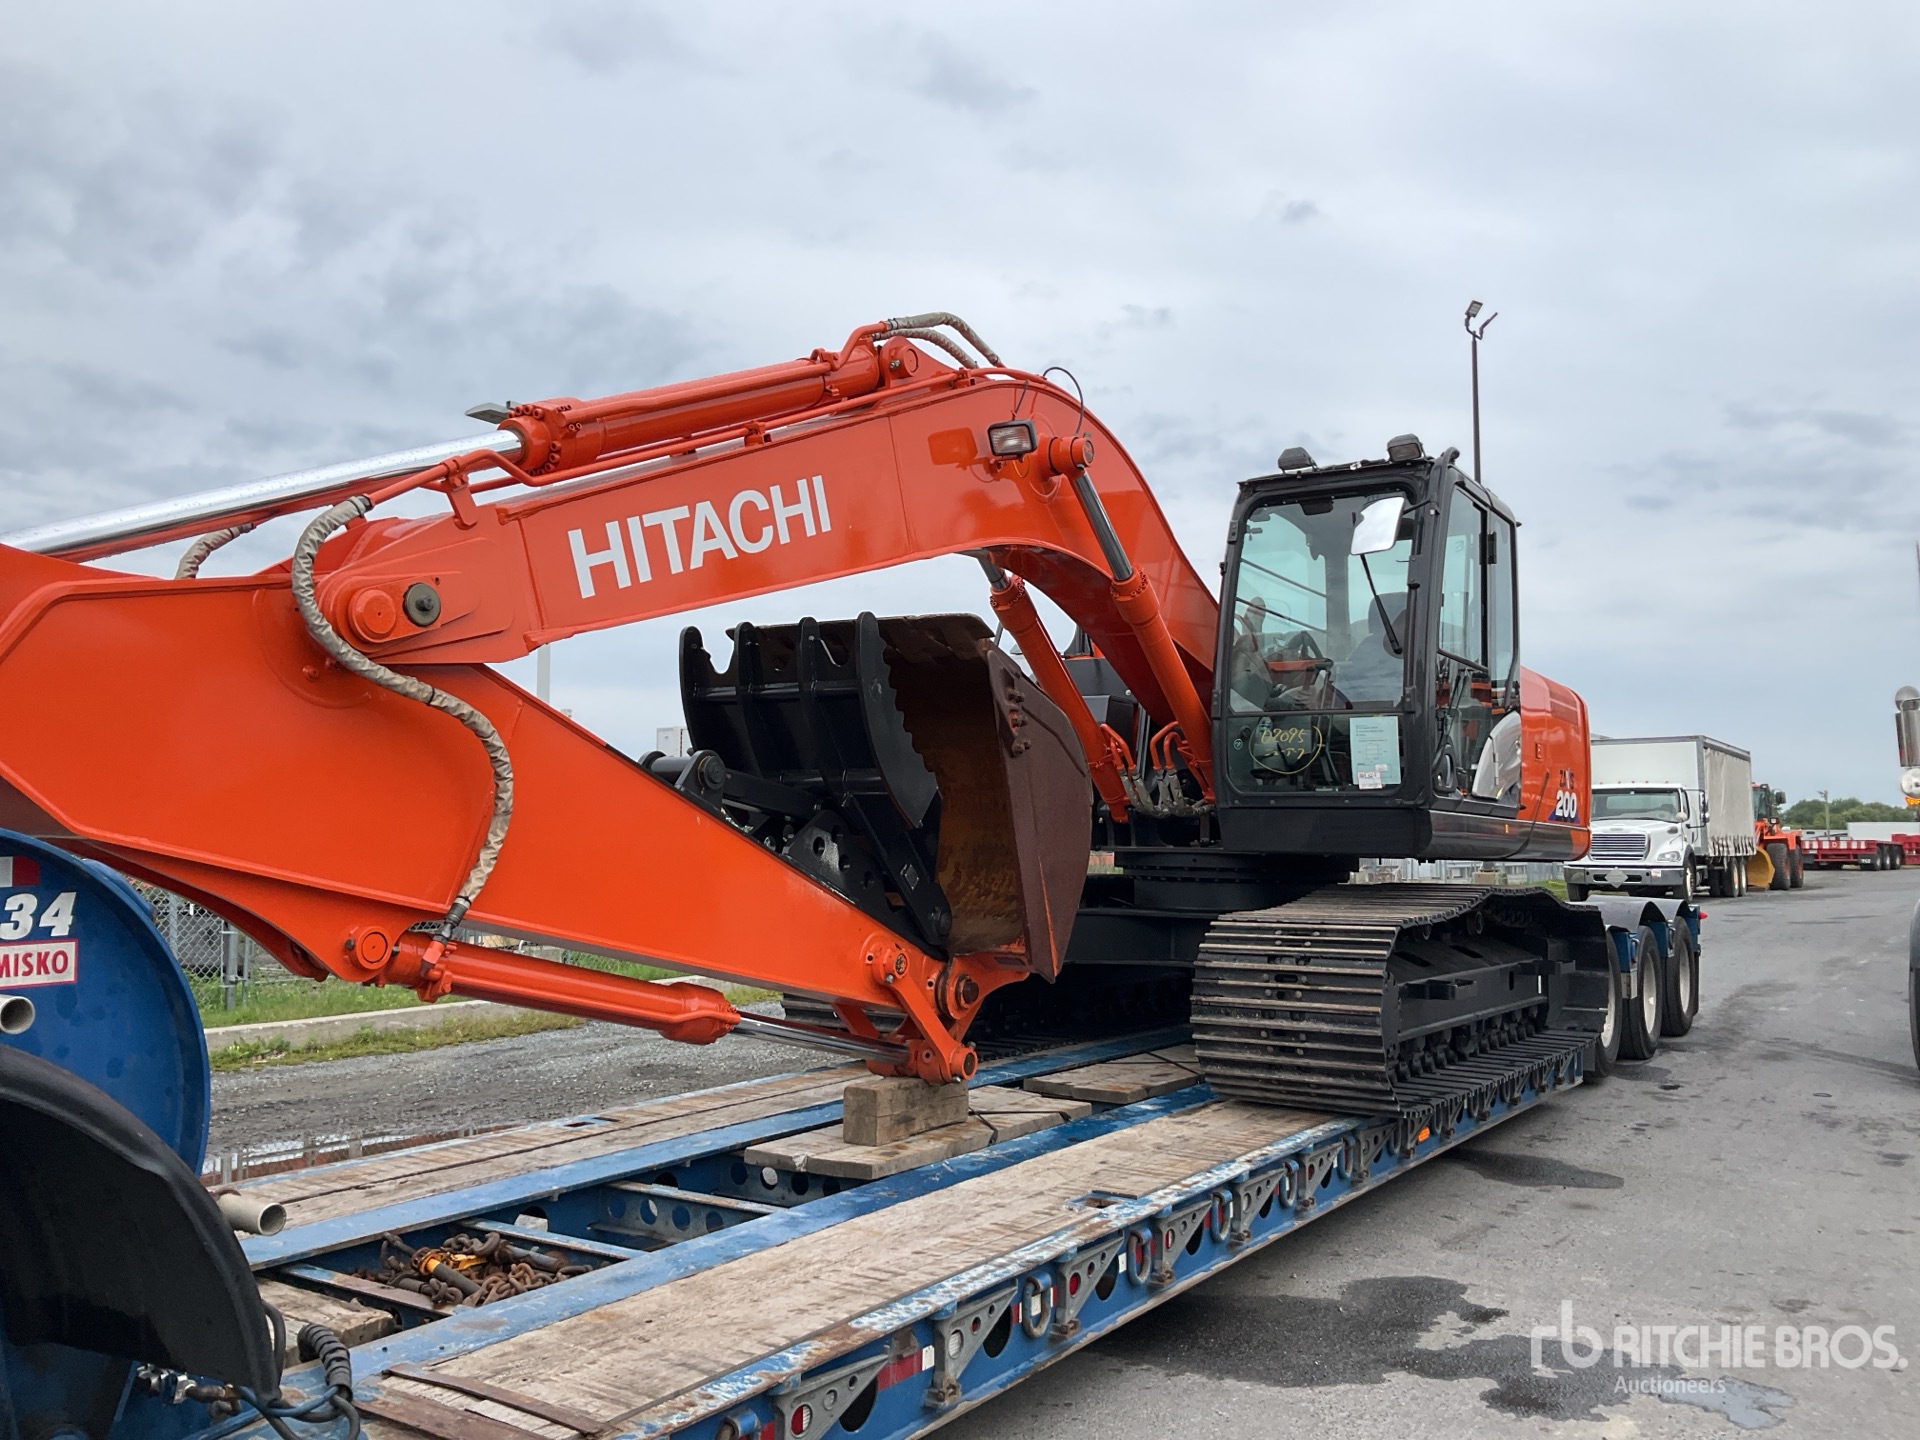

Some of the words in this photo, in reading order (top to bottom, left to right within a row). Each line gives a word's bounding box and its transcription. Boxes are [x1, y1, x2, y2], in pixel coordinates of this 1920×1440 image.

[567, 475, 832, 599] HITACHI
[1555, 789, 1577, 818] 200
[0, 891, 77, 941] 34
